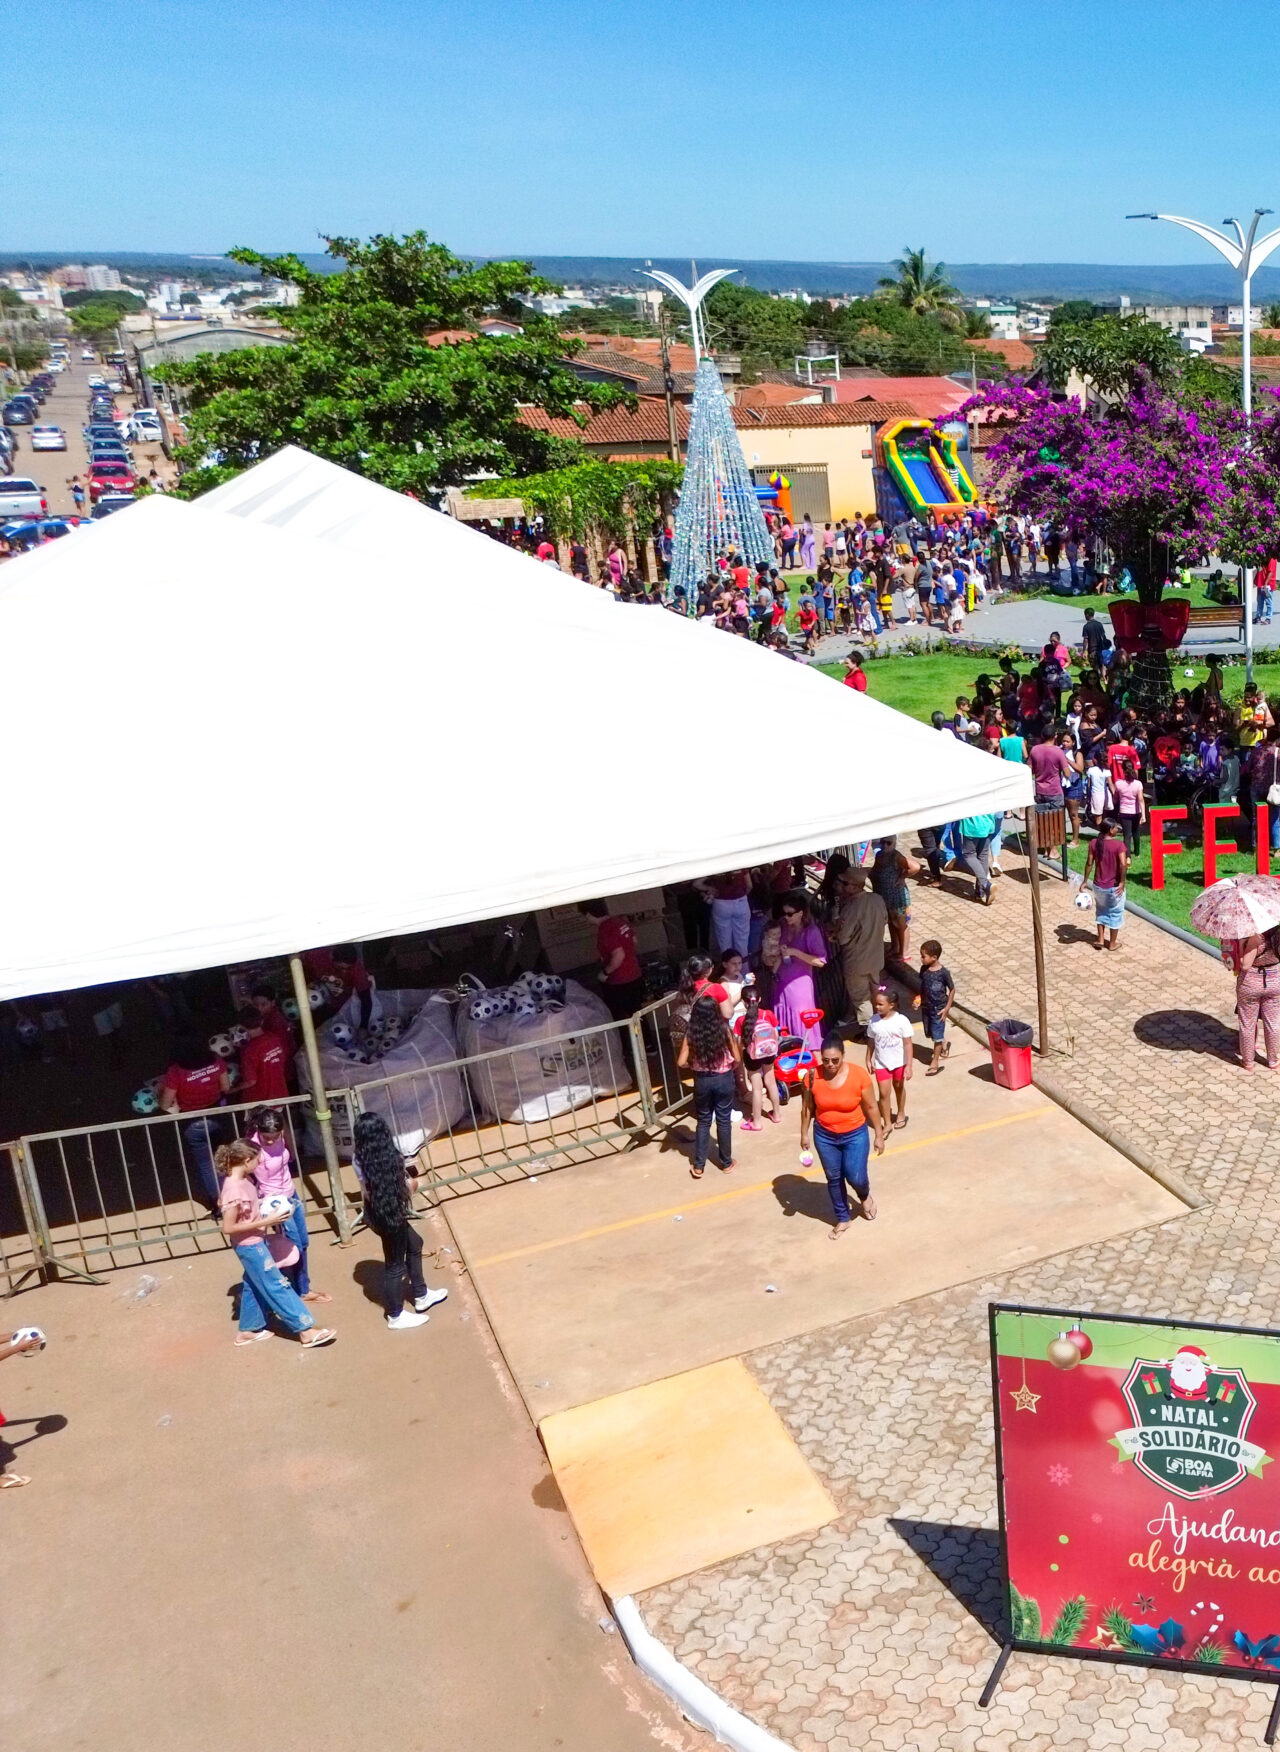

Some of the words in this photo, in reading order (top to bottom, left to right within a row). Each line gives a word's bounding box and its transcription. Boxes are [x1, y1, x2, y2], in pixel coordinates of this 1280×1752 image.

[1161, 1404, 1219, 1427] NATAL
[1138, 1429, 1241, 1459] SOLIDÁRIO
[1184, 1458, 1214, 1473] BOA
[1184, 1469, 1214, 1478] SAFRA
[1128, 1539, 1241, 1592] alegria
